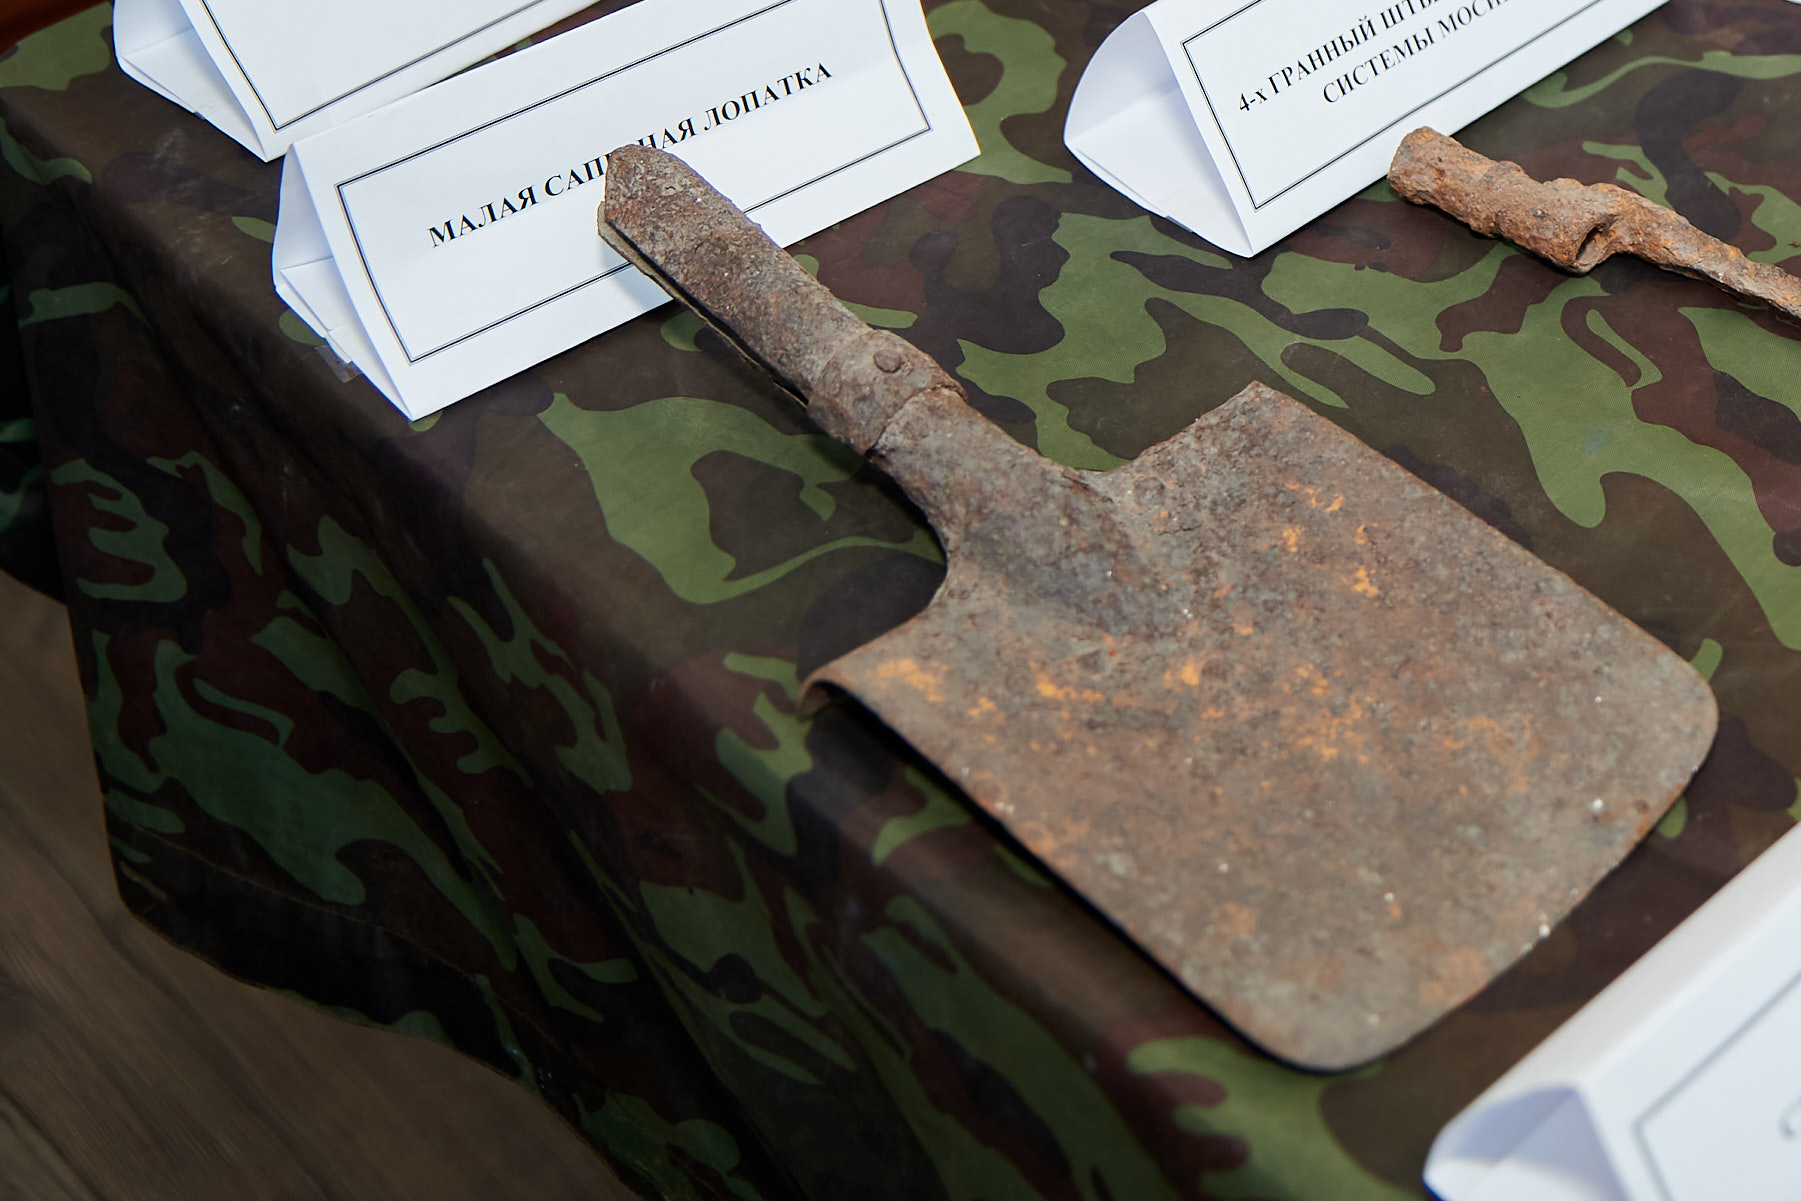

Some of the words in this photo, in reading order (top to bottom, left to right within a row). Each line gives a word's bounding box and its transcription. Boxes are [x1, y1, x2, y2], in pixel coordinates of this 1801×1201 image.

[1238, 87, 1267, 113] 4-х
[1267, 16, 1377, 94] ГРАННЫЙ
[1322, 27, 1434, 103] СИСТЕМЫ
[428, 186, 539, 247] МАЛАЯ
[544, 117, 696, 197] САПНАЯ
[704, 63, 832, 131] ЛОПАТКА
